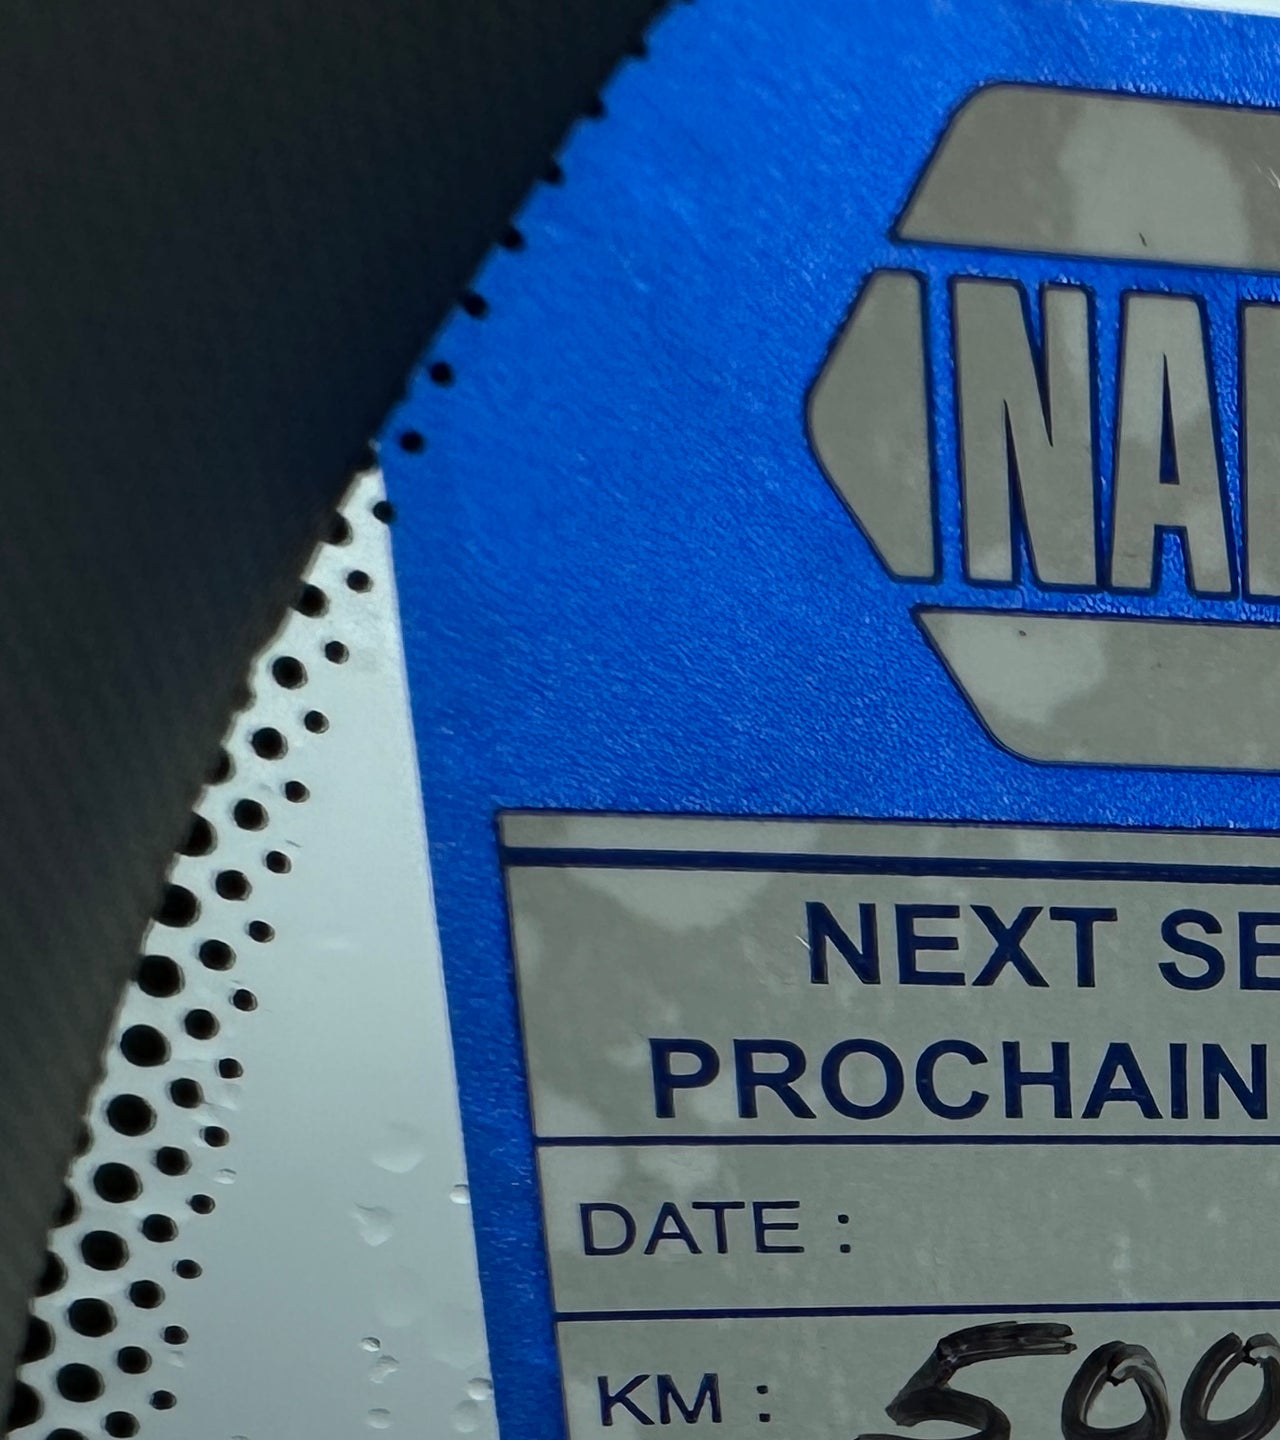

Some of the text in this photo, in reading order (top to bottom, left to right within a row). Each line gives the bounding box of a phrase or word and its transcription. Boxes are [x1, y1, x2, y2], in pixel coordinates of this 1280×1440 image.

[804, 901, 1118, 989] NEXT
[647, 1037, 1270, 1121] PROCHAIN
[578, 1200, 806, 1257] DATE
[596, 1372, 723, 1427] KM
